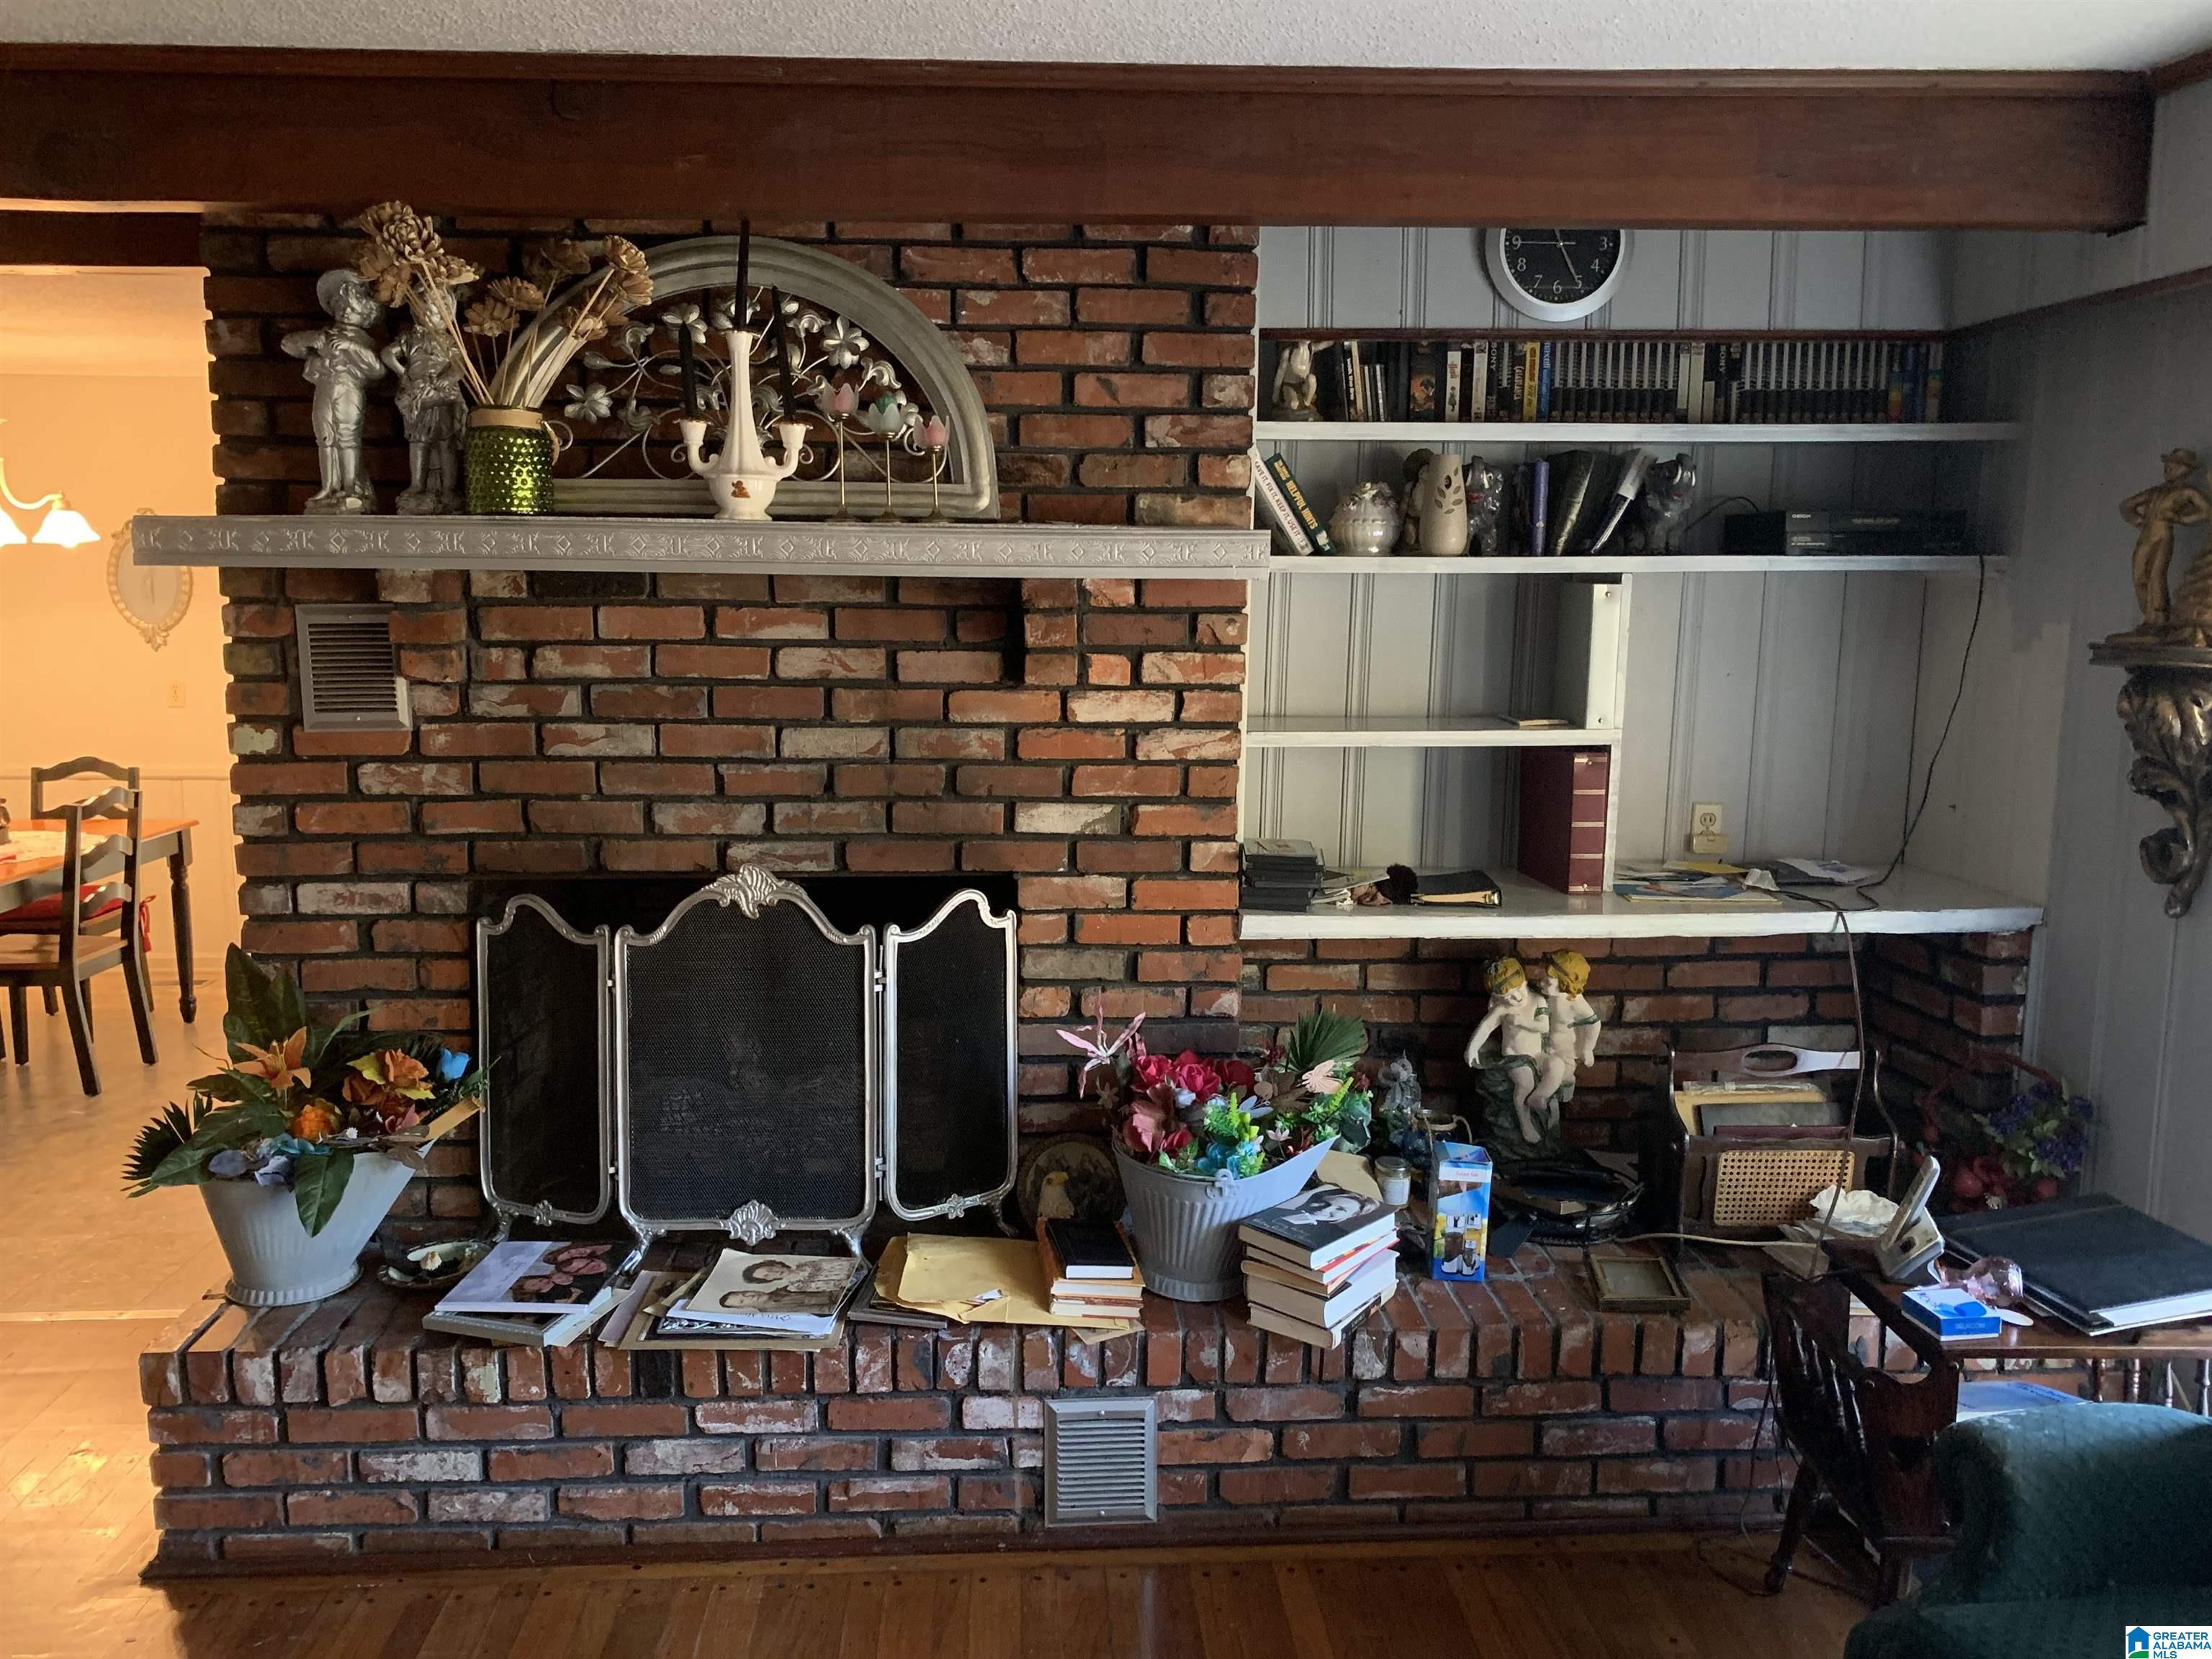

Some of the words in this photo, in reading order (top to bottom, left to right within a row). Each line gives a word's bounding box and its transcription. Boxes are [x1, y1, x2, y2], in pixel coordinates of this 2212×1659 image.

[1512, 235, 1521, 250] 9
[1599, 236, 1608, 251] 3
[1516, 257, 1527, 271] 8
[1590, 258, 1600, 272] 4
[1534, 274, 1543, 289] 7
[1552, 279, 1562, 295] 6
[1575, 275, 1583, 289] 5
[1285, 480, 1307, 511] HELPFUL
[1275, 498, 1287, 514] KEEP
[1287, 519, 1297, 532] USE
